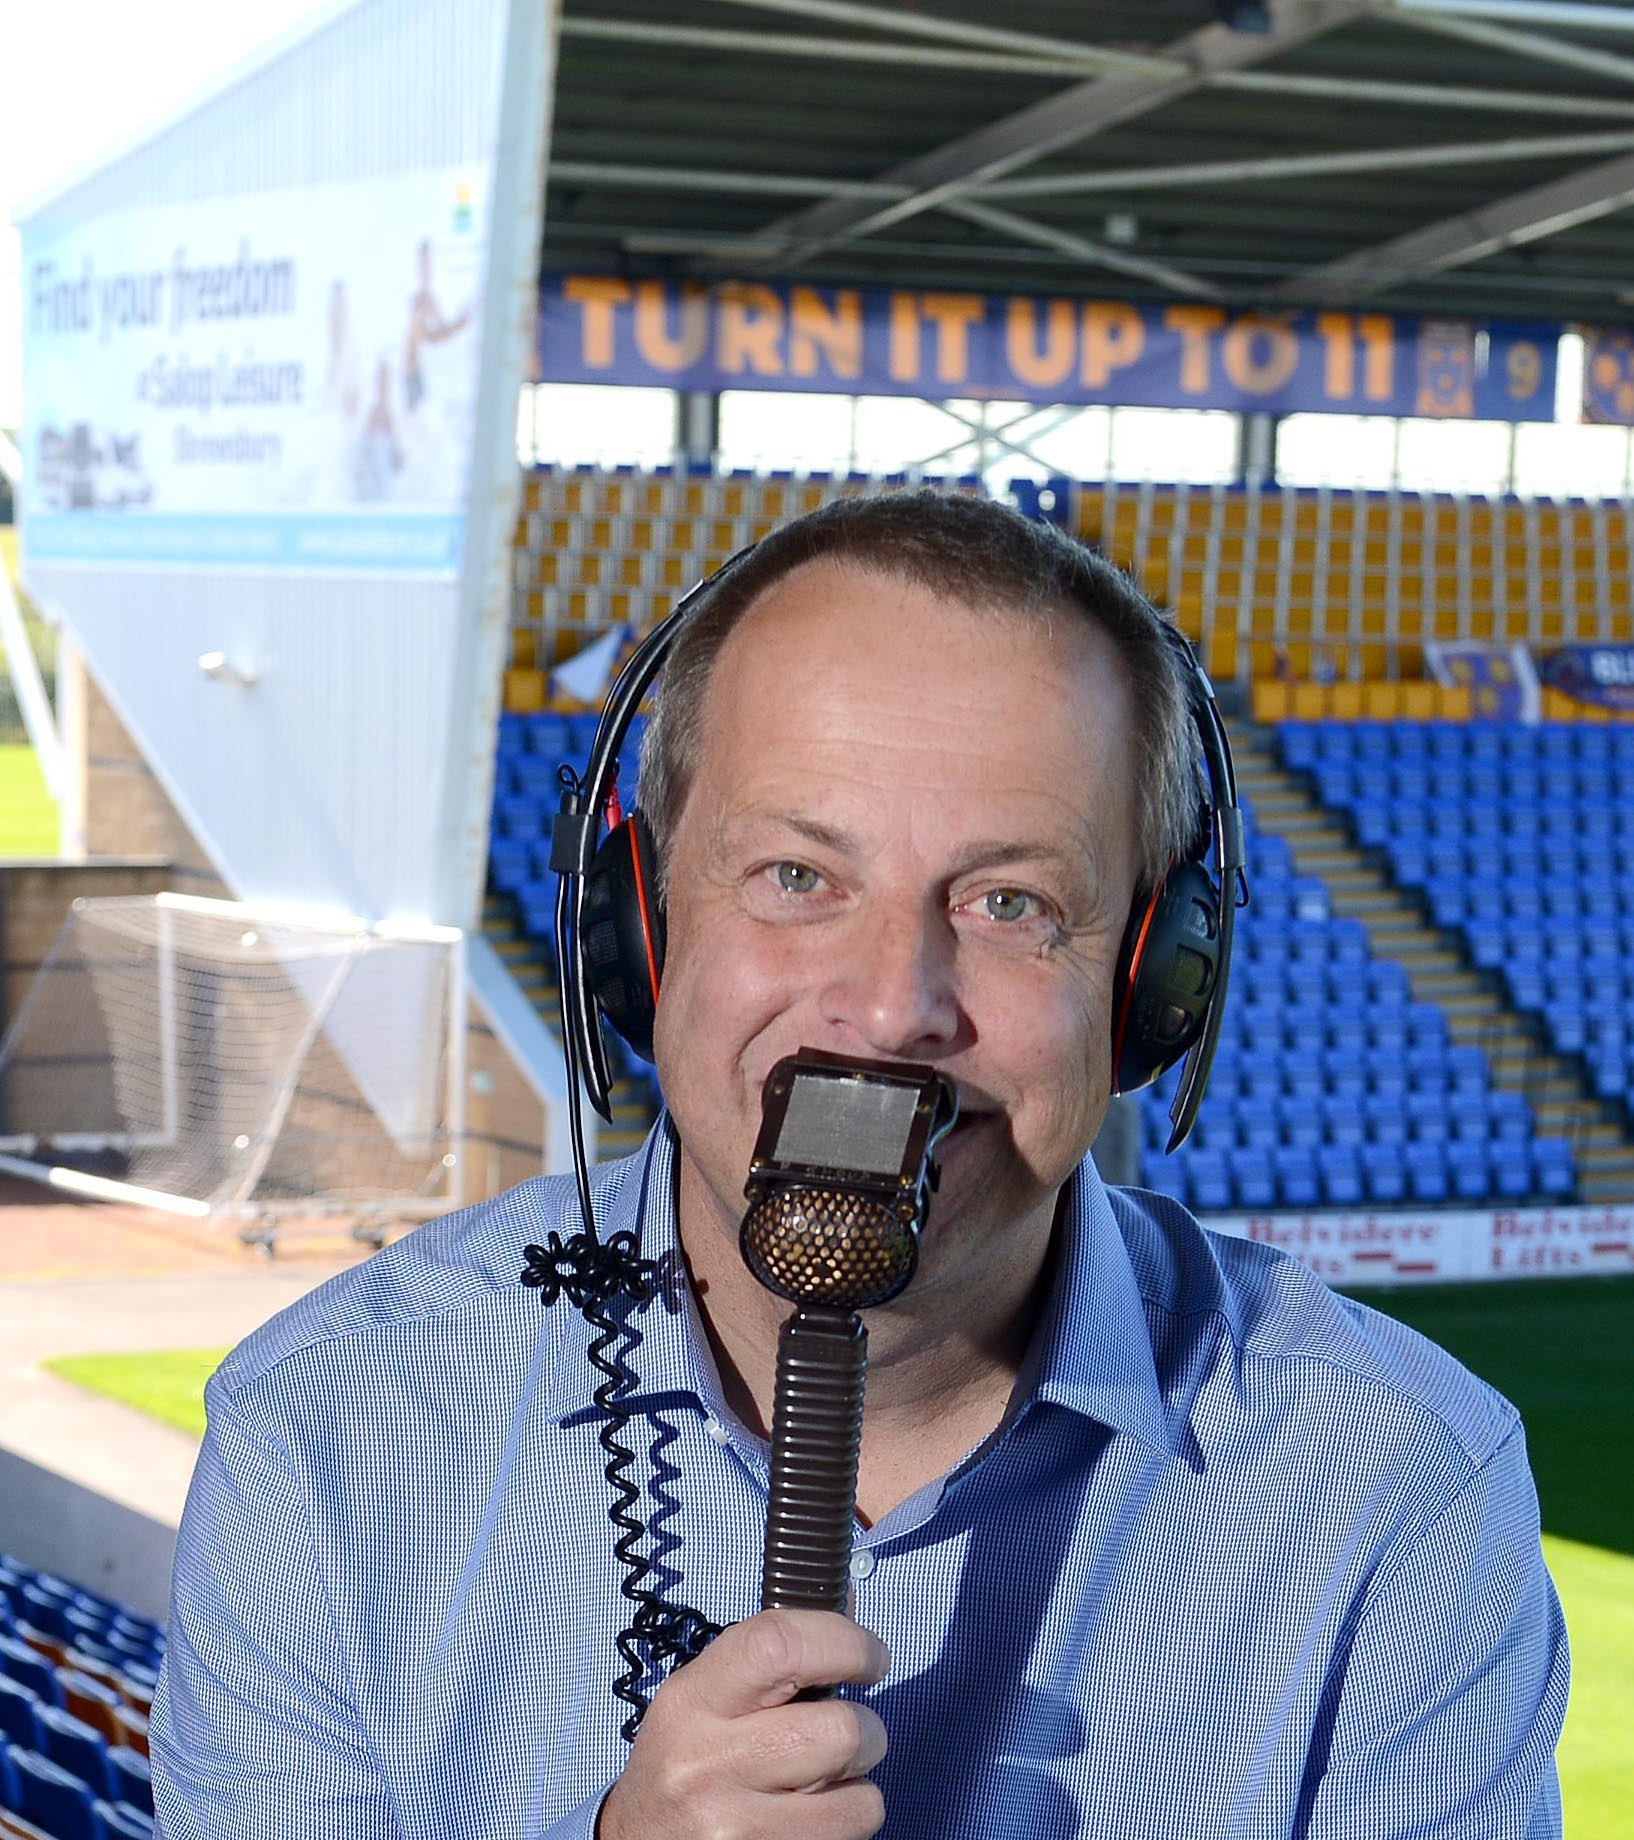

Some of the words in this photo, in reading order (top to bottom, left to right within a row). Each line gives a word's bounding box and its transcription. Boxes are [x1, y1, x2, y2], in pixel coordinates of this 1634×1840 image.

[32, 255, 93, 333] Find
[100, 270, 164, 347] your
[170, 235, 297, 335] freedom
[565, 276, 862, 378] TURN
[890, 293, 985, 383] IT
[1006, 298, 1145, 391] UP
[1166, 305, 1300, 395] TO
[1317, 312, 1395, 400] 11
[1505, 342, 1540, 401] 9
